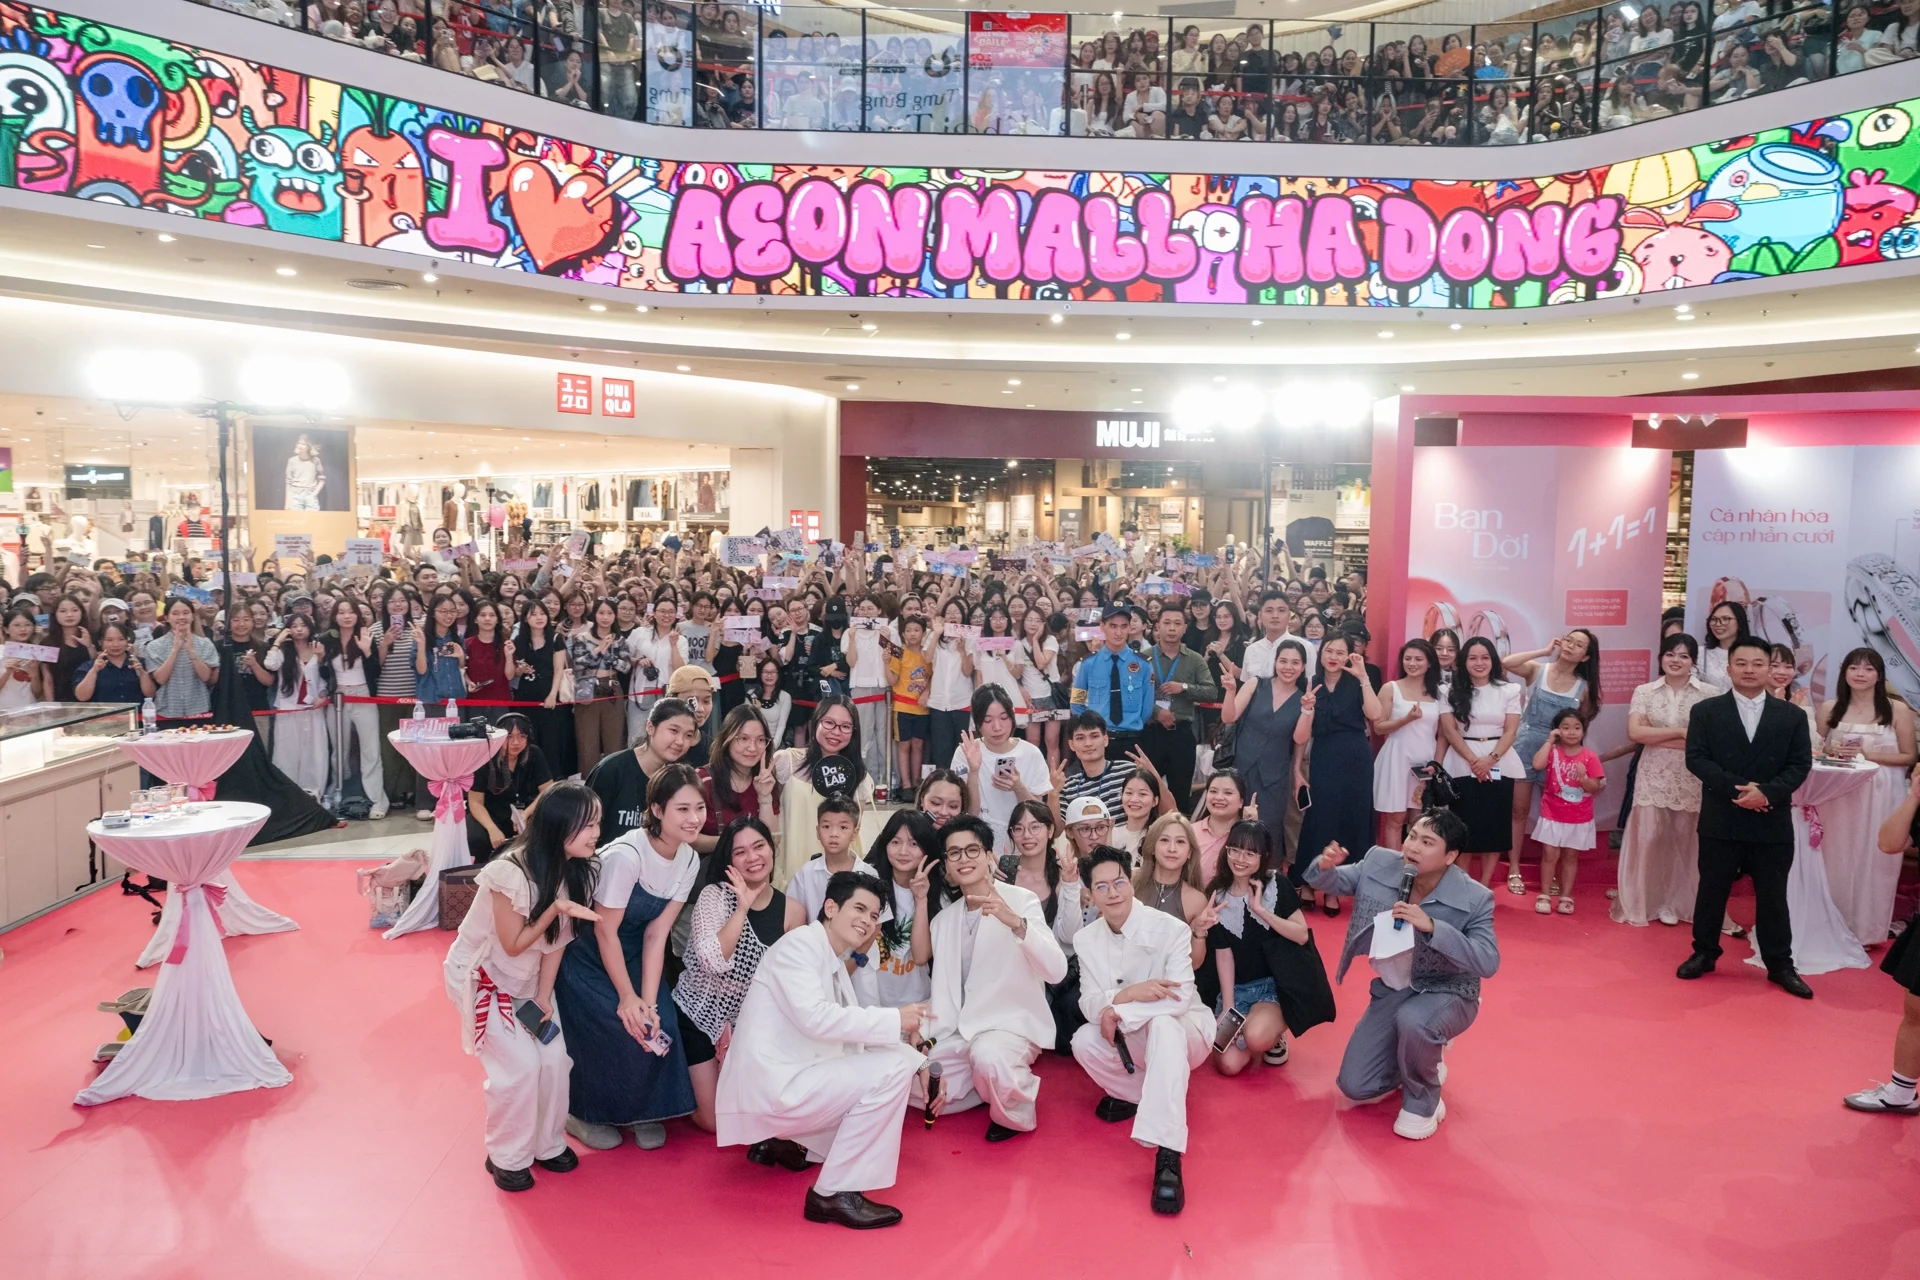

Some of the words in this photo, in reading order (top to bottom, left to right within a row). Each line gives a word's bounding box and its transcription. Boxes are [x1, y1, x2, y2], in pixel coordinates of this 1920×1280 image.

[426, 127, 508, 255] I
[665, 178, 931, 281] AEON
[934, 185, 1199, 285] MALL
[1238, 194, 1367, 284] HA
[1382, 196, 1622, 284] DONG
[604, 383, 630, 398] UNI
[604, 398, 632, 414] QLO
[1096, 420, 1160, 448] MUJI
[1434, 502, 1503, 533] Bạn
[1710, 507, 1735, 523] Cá
[1738, 508, 1787, 522] nhân
[1791, 508, 1829, 523] hóa
[1740, 525, 1788, 543] nhẫn
[1792, 528, 1835, 543] cưới
[822, 765, 838, 776] Da
[825, 773, 847, 788] LAB
